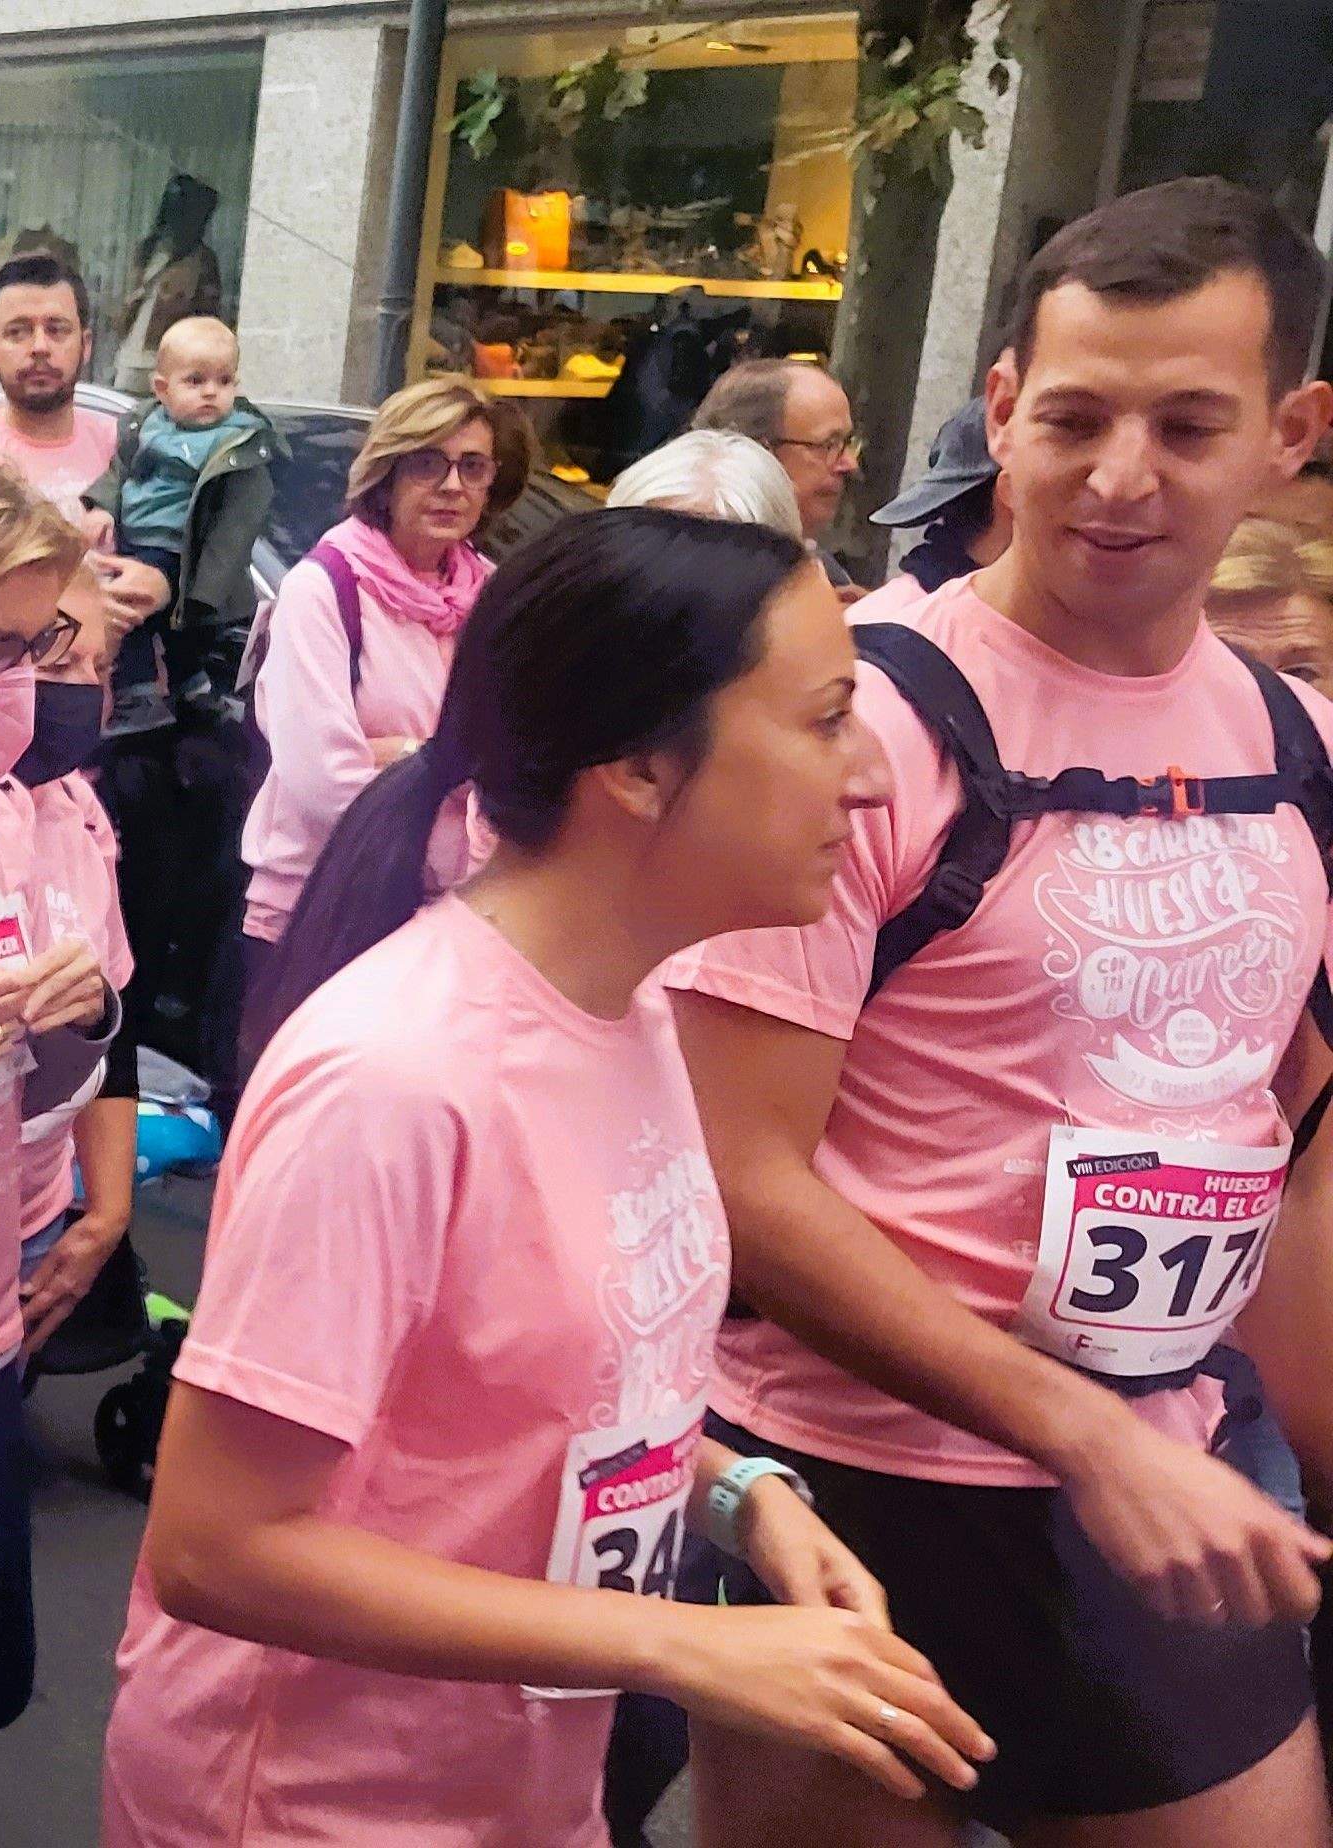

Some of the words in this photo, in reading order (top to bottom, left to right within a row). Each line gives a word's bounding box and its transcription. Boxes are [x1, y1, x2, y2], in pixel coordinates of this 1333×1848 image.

[1097, 851, 1248, 935] HUESCA
[1073, 1163, 1093, 1175] VIII
[1095, 1155, 1152, 1173] EDICIÓN
[1095, 1183, 1217, 1218] CONTRA
[1223, 1197, 1246, 1218] EL
